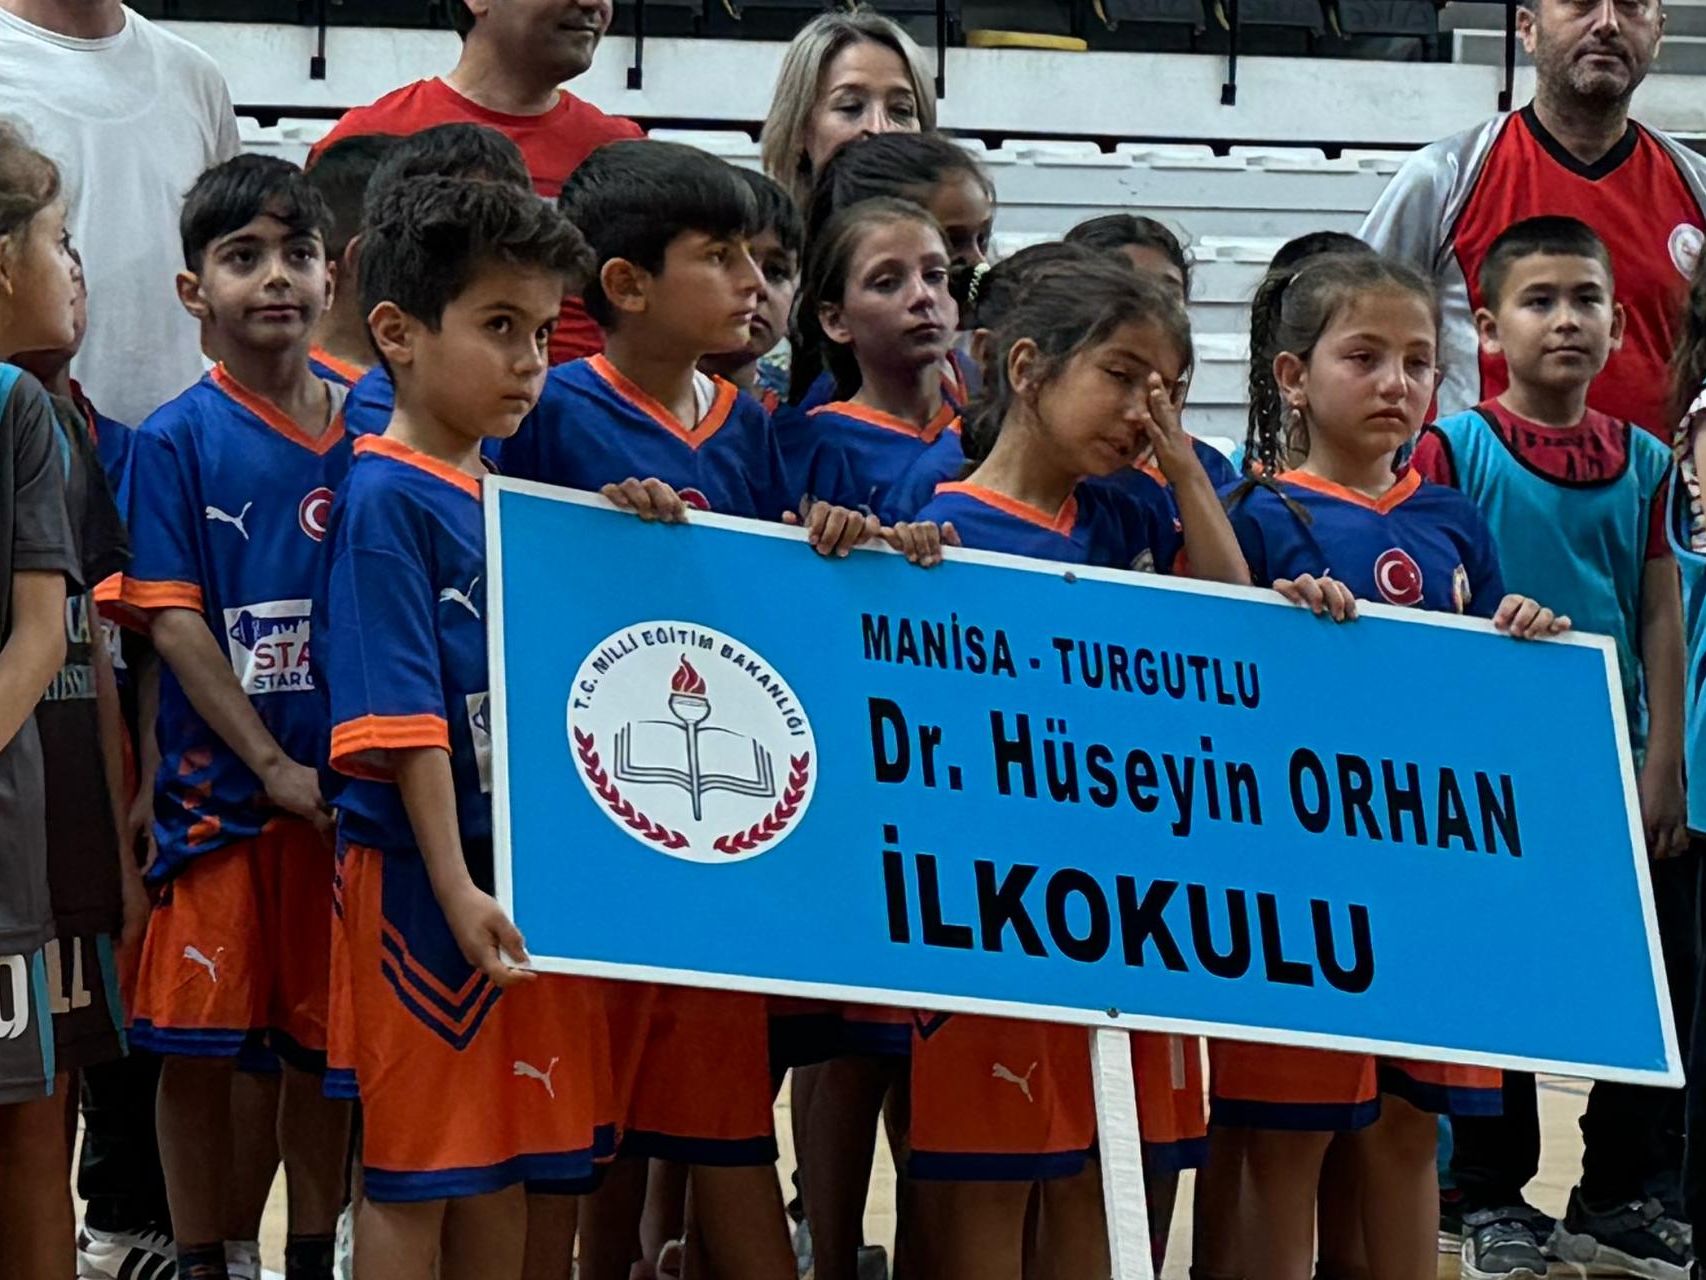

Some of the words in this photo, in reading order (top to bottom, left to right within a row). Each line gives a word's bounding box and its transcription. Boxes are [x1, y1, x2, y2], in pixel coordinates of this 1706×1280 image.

[574, 677, 599, 710] T.C.
[719, 643, 806, 737] BAKANLIĞI
[861, 613, 1017, 678] MANİSA
[1052, 637, 1260, 709] TURGUTLU
[868, 696, 963, 791] Dr.
[990, 710, 1263, 837] Hüseyin
[1289, 747, 1522, 858] ORHAN
[882, 824, 1376, 994] İLKOKULU
